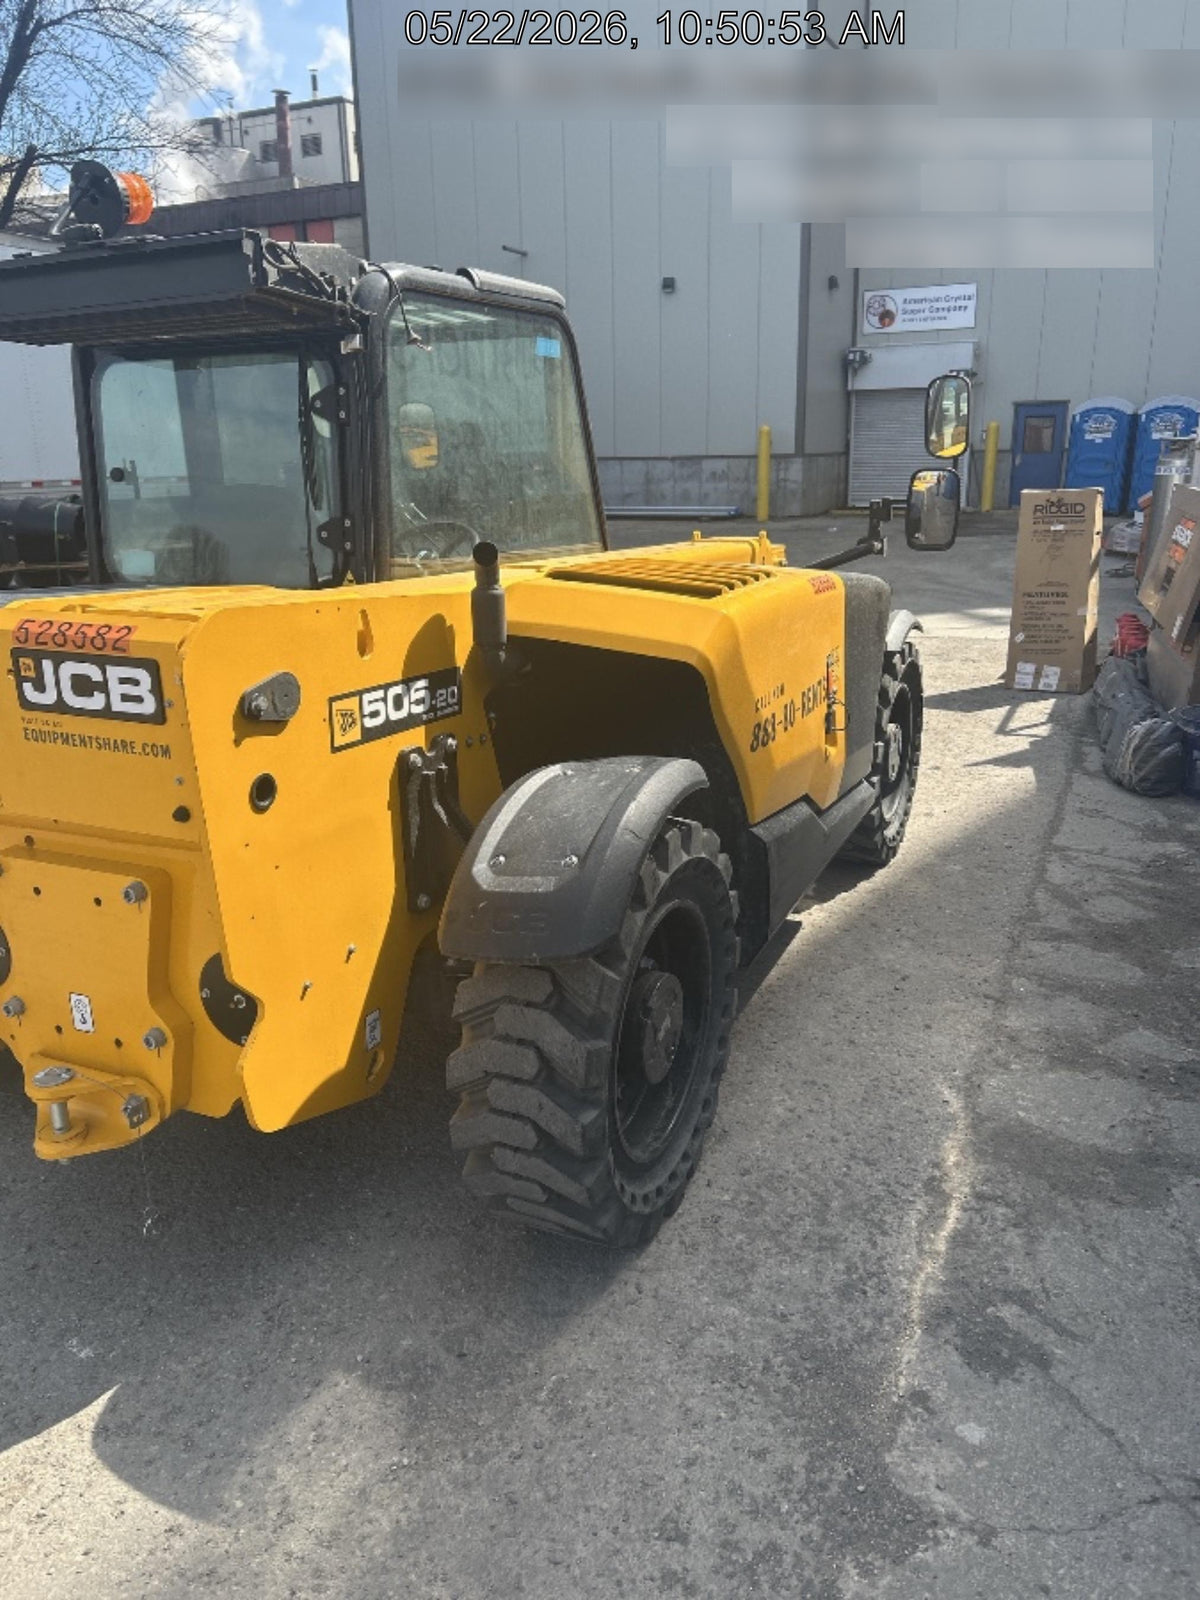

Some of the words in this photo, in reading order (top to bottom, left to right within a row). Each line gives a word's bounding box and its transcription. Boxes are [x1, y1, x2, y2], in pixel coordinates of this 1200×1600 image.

[902, 296, 942, 305] American
[944, 293, 975, 304] Crystal
[1032, 502, 1086, 515] RIDGID
[15, 618, 132, 653] 528582
[21, 658, 158, 716] JCB
[22, 727, 172, 760] EQUIPMENTSHARE.COM
